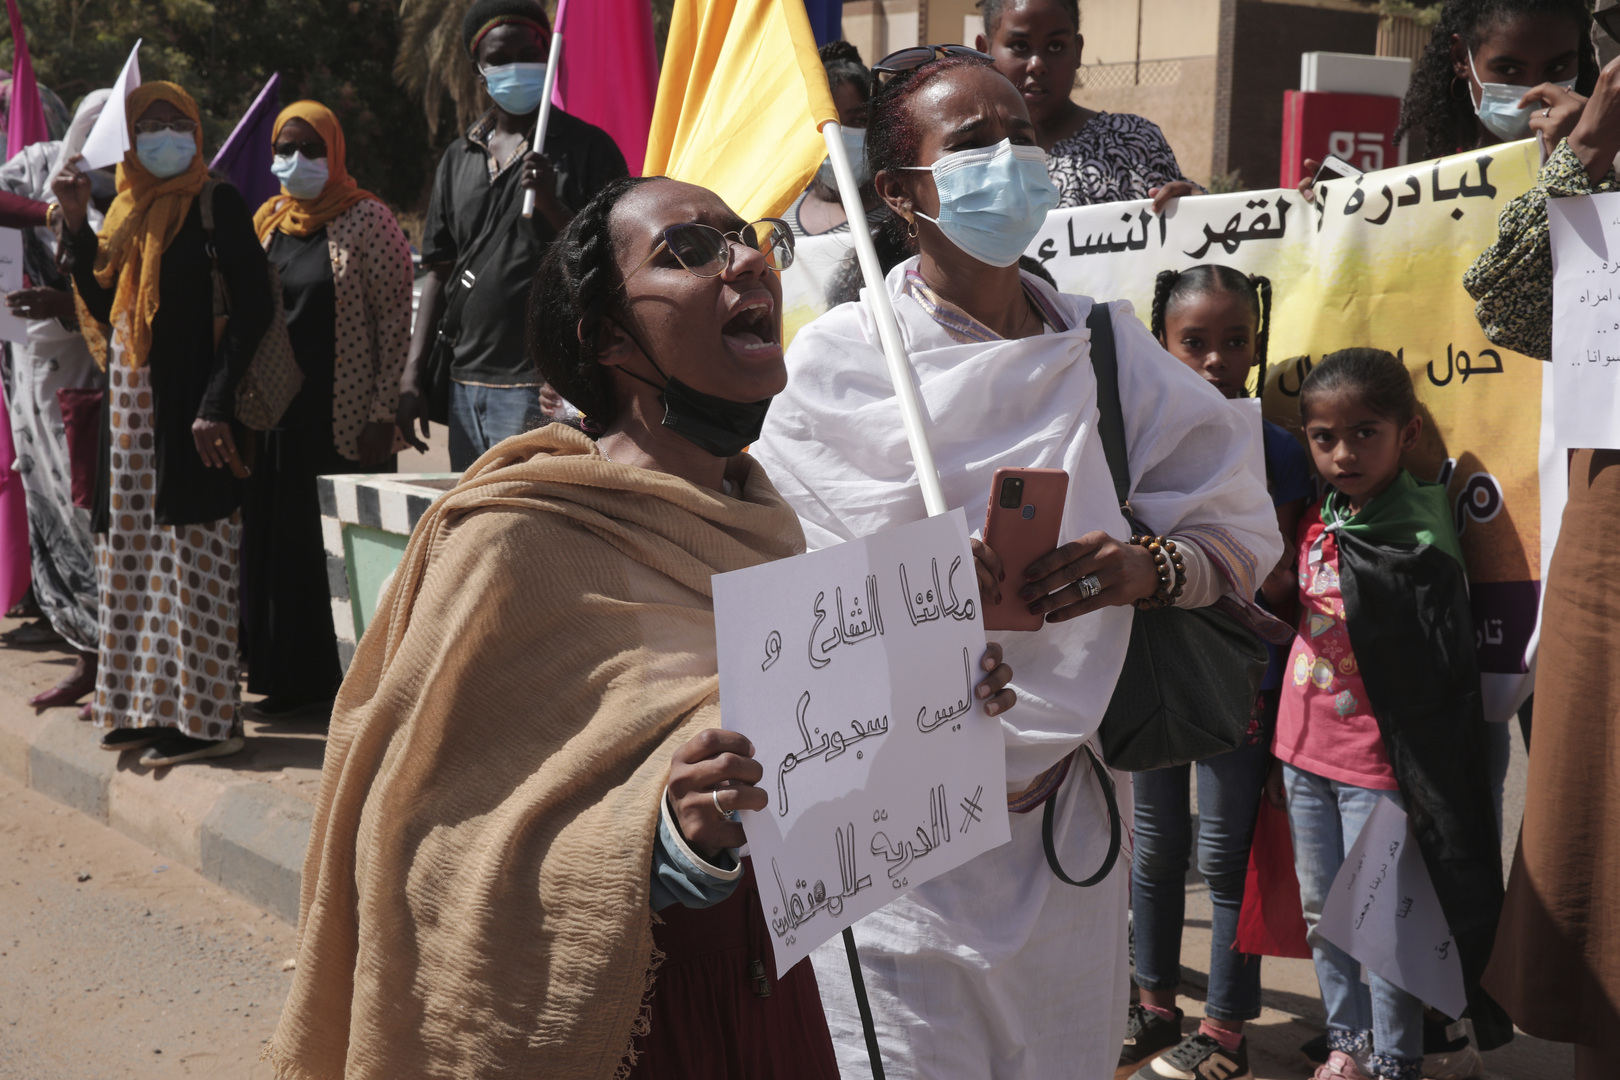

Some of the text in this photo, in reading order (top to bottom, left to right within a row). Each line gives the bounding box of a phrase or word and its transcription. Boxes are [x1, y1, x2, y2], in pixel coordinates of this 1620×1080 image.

[1038, 208, 1167, 264] النساء
[1183, 195, 1292, 259] لقهر
[1427, 342, 1505, 387] حول
[761, 629, 782, 672] و
[808, 574, 884, 669] الشارع
[777, 646, 972, 817] ليس سجونكم
